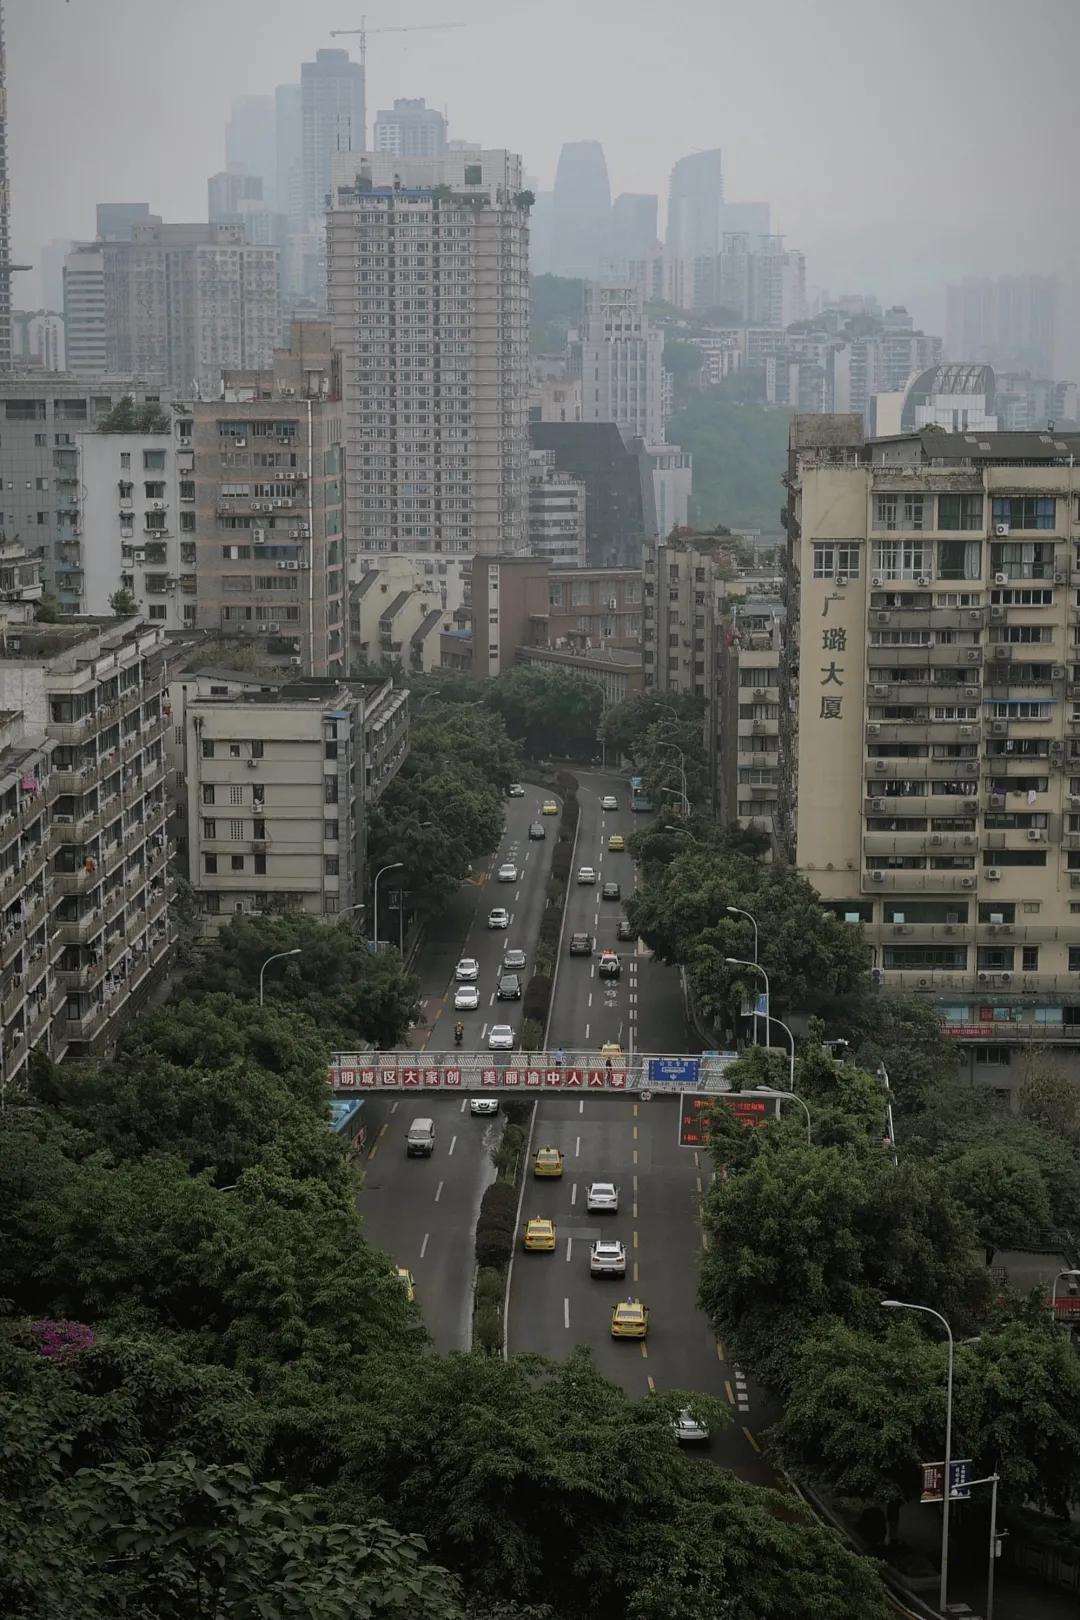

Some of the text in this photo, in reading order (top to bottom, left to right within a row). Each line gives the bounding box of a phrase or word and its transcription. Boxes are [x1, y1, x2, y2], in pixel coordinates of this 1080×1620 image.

[820, 592, 847, 719] 广璐大厦
[482, 1070, 626, 1087] 美丽渝中人人享
